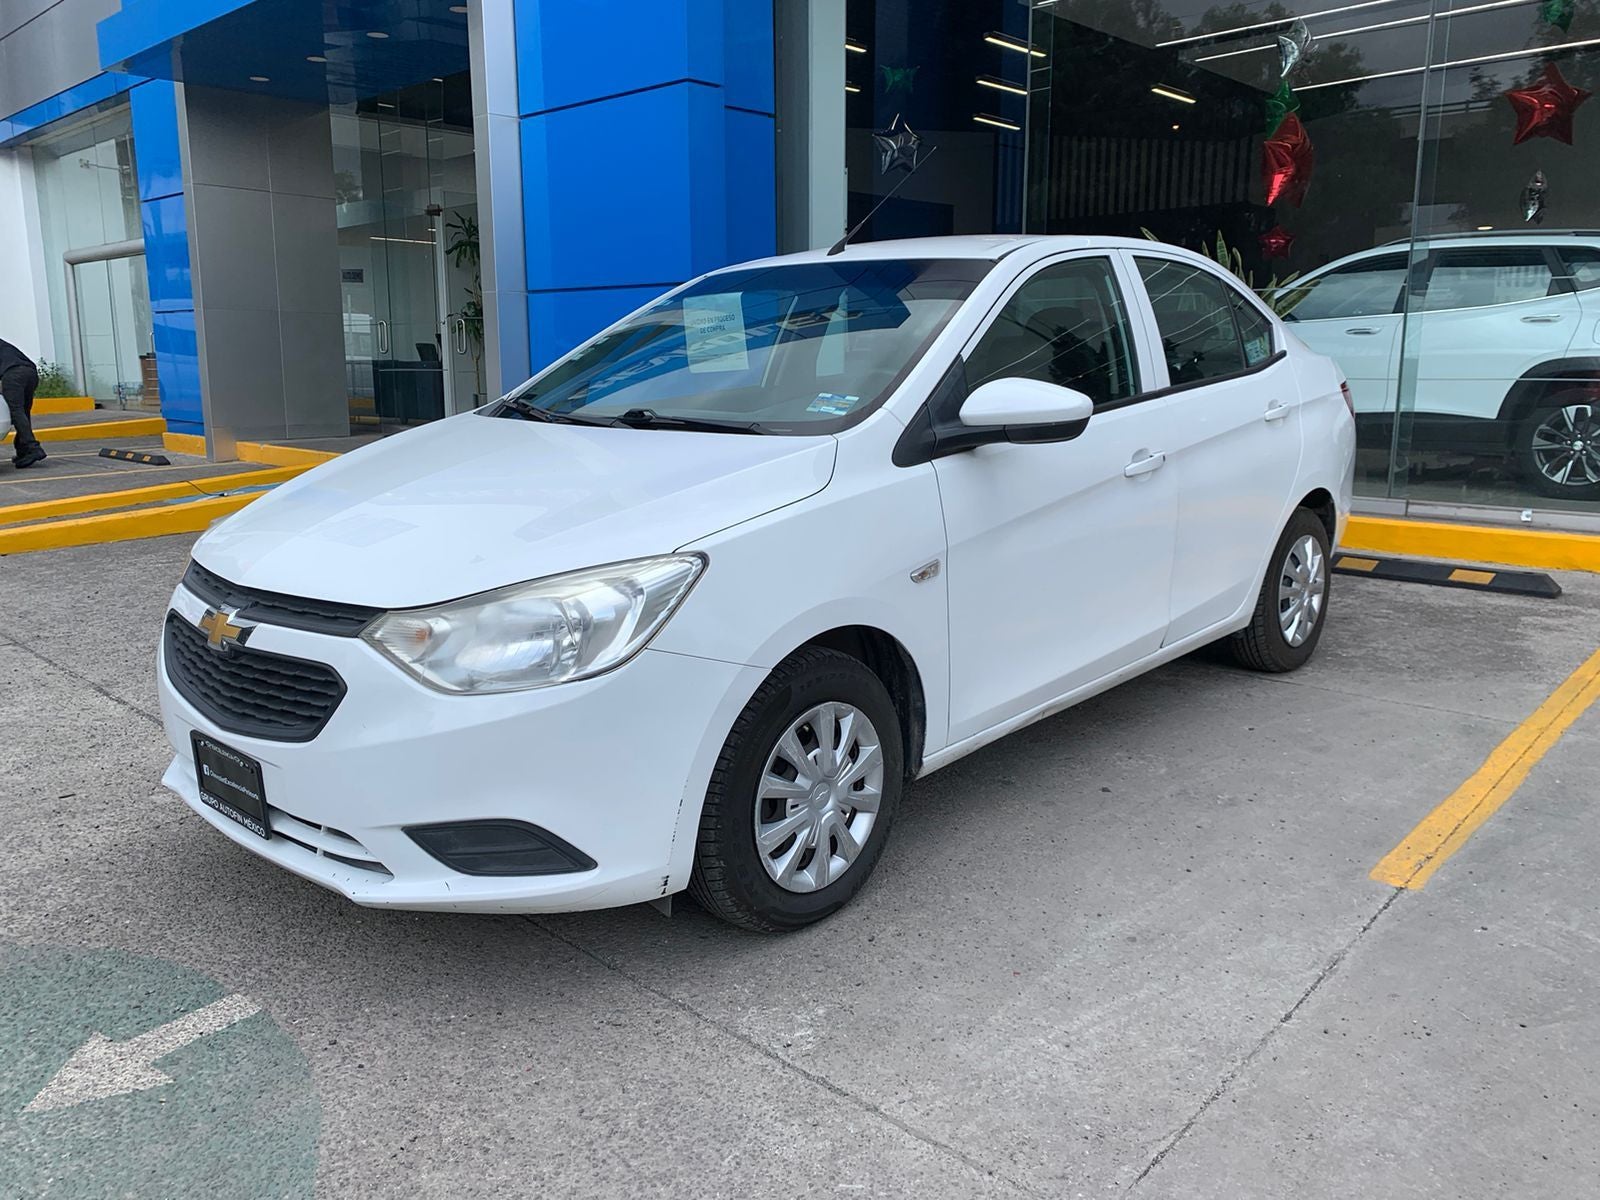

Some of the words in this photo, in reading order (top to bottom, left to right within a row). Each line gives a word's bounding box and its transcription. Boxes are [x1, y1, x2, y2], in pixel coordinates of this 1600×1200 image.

[707, 325, 726, 333] COMPRA
[200, 791, 219, 809] GRUPO
[219, 802, 243, 823] AUTOFIN
[243, 816, 265, 837] MÉXICO
